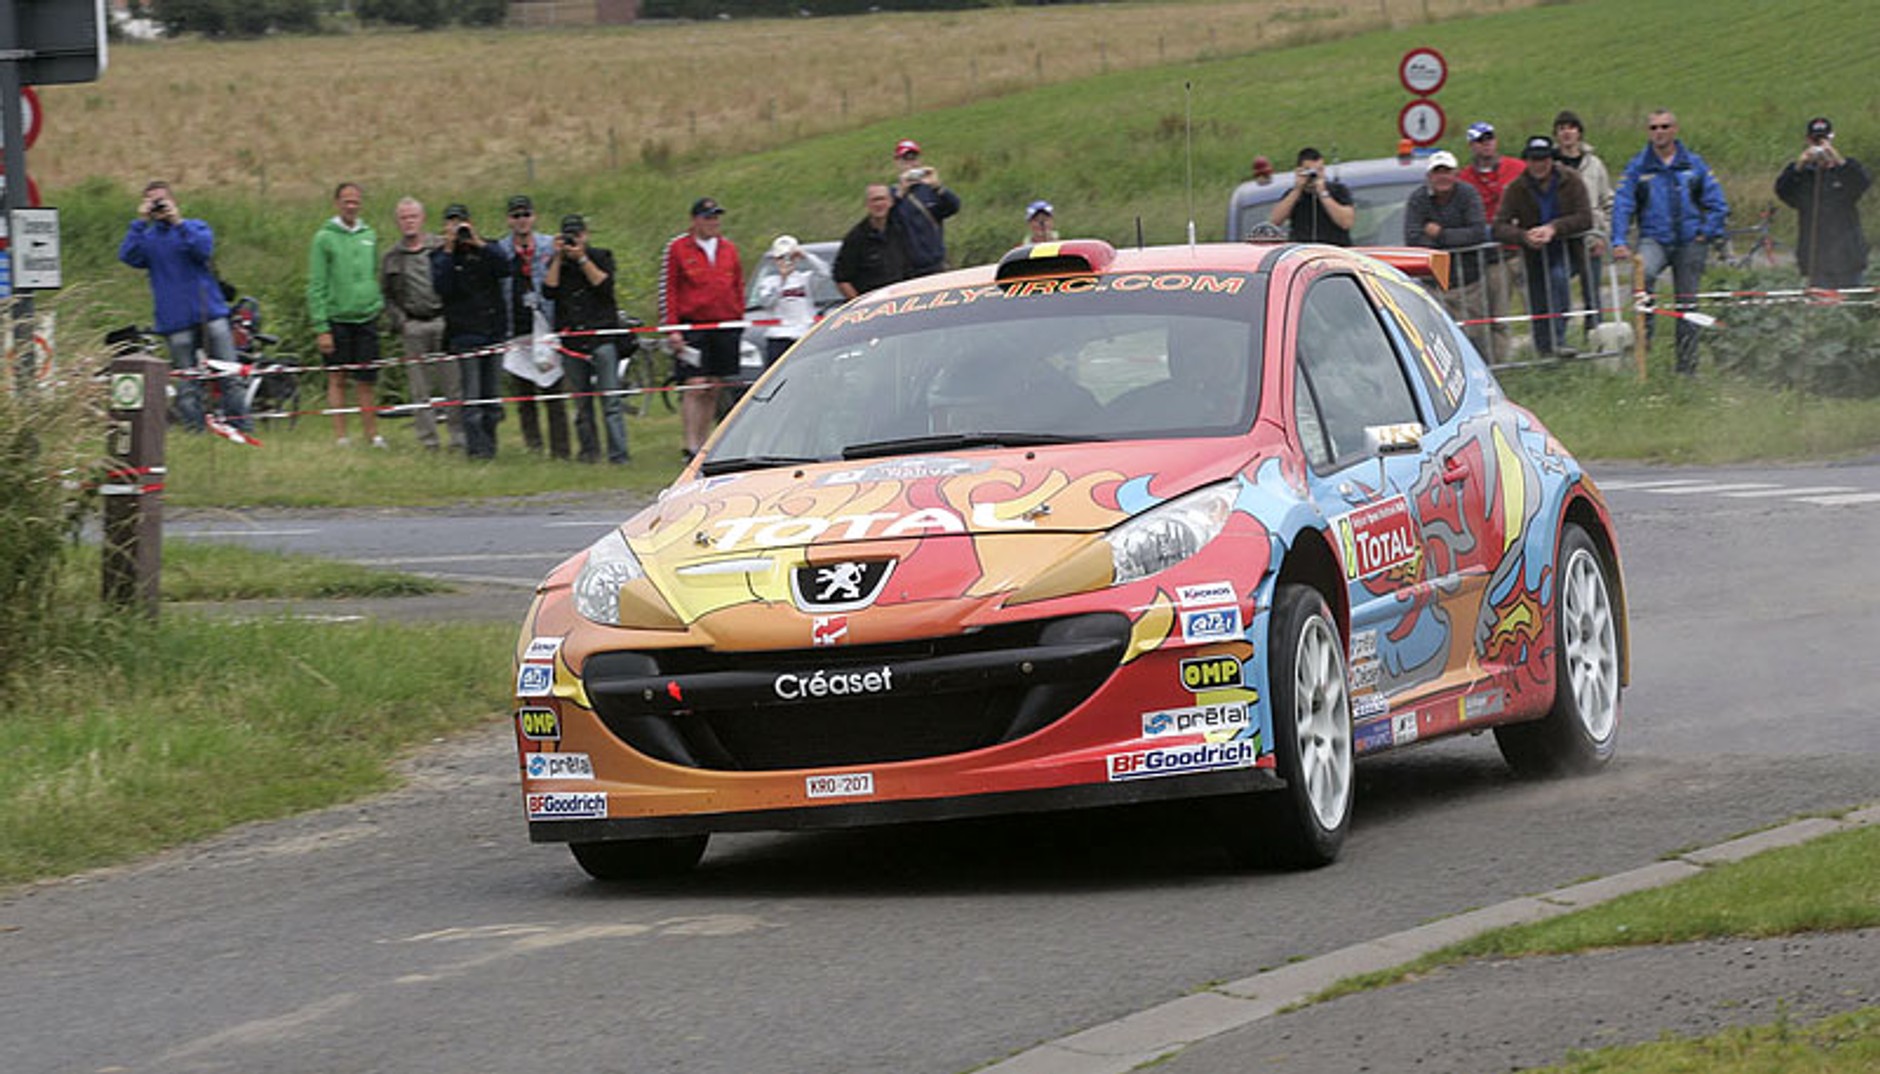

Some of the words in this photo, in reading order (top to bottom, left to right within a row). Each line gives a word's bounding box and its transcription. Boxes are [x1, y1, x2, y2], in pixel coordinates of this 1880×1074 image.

[830, 274, 1245, 330] RALLY-IRC.COM
[711, 502, 1035, 551] TOTAL
[1356, 526, 1415, 570] TOTAL
[774, 665, 893, 699] Créaset
[1184, 660, 1238, 686] OMP
[523, 712, 556, 734] OMP
[1112, 742, 1253, 773] BFGoodrich
[529, 793, 606, 813] BFGoodrich
